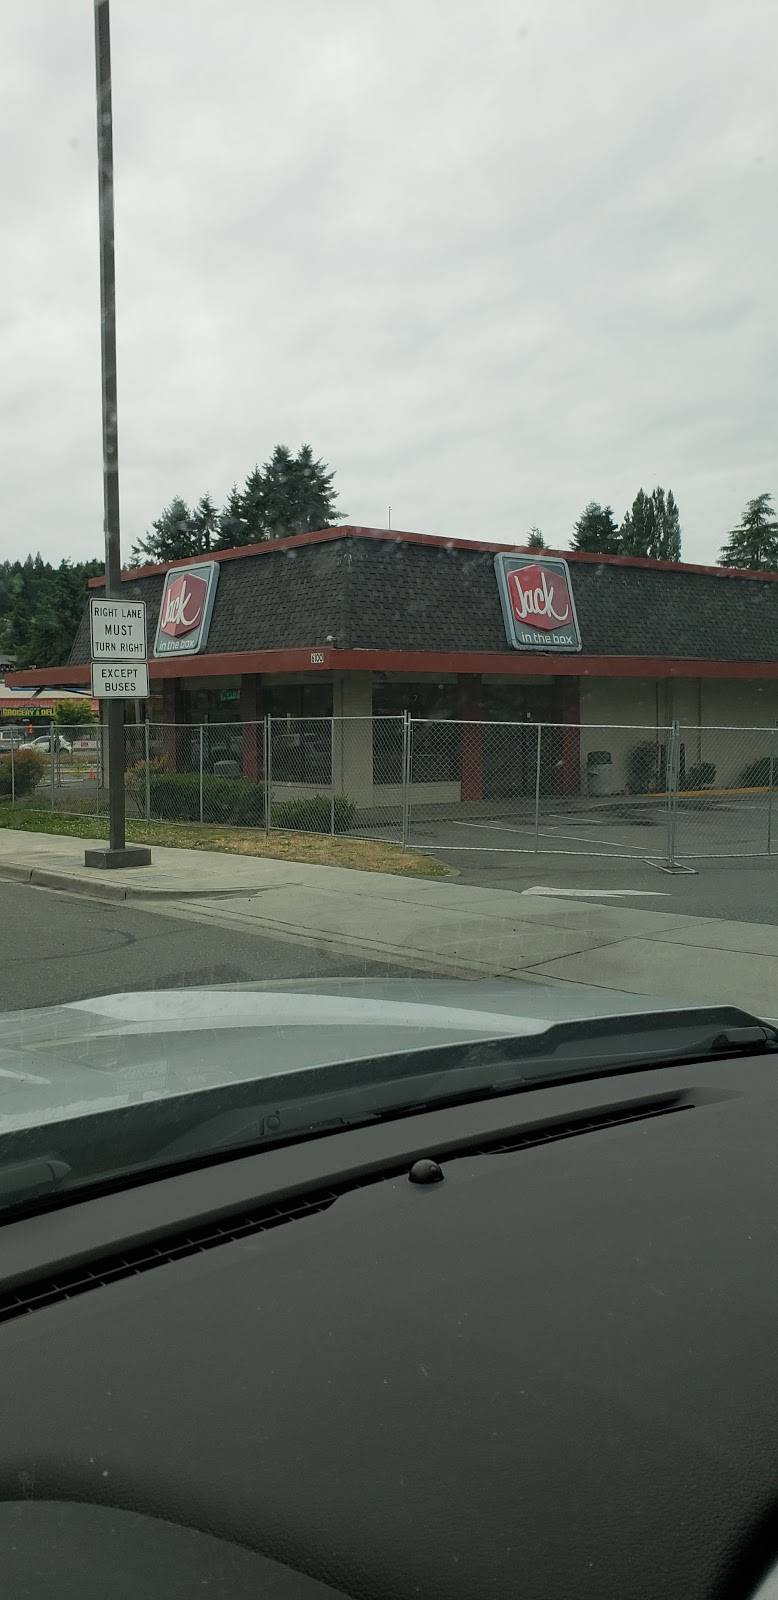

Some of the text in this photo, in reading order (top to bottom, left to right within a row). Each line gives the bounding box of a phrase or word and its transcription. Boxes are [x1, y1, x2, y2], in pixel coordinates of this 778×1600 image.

[514, 571, 569, 621] Jack
[161, 580, 201, 628] Jack
[94, 607, 142, 619] RIGHT LANE
[104, 624, 133, 636] MUST
[521, 632, 573, 644] in the box
[95, 642, 144, 653] TURN RIGHT
[159, 640, 195, 650] in the box
[101, 668, 138, 678] EXCEPT
[104, 682, 136, 692] BUSES
[3, 708, 34, 717] GROCERY
[41, 708, 56, 717] DELI
